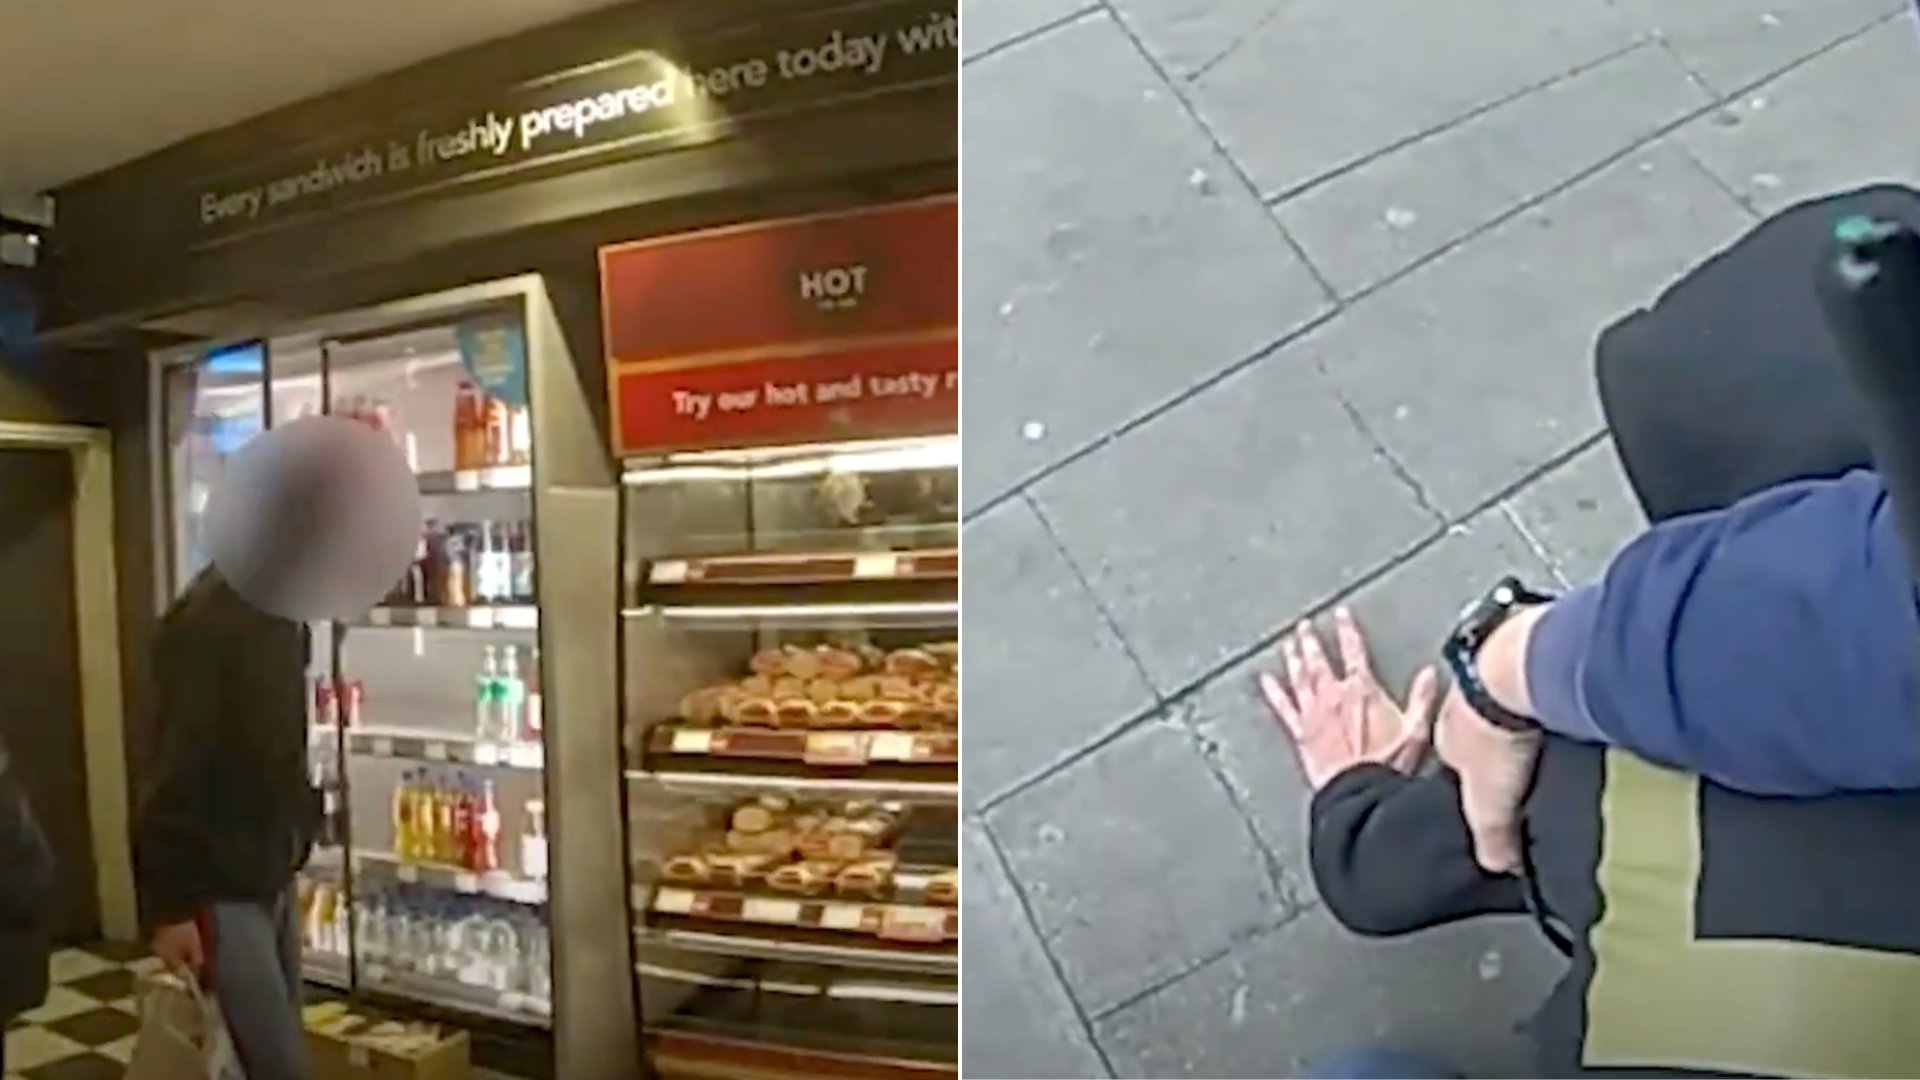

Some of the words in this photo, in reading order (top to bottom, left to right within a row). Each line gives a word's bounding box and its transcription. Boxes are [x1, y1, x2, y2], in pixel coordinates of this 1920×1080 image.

[416, 111, 513, 164] freshly
[521, 77, 675, 150] prepared
[776, 31, 886, 76] today
[800, 265, 867, 298] HOT
[672, 389, 711, 421] Try
[718, 388, 757, 412] our
[765, 381, 807, 405] hot
[815, 374, 861, 401] and
[869, 370, 938, 399] tasty
